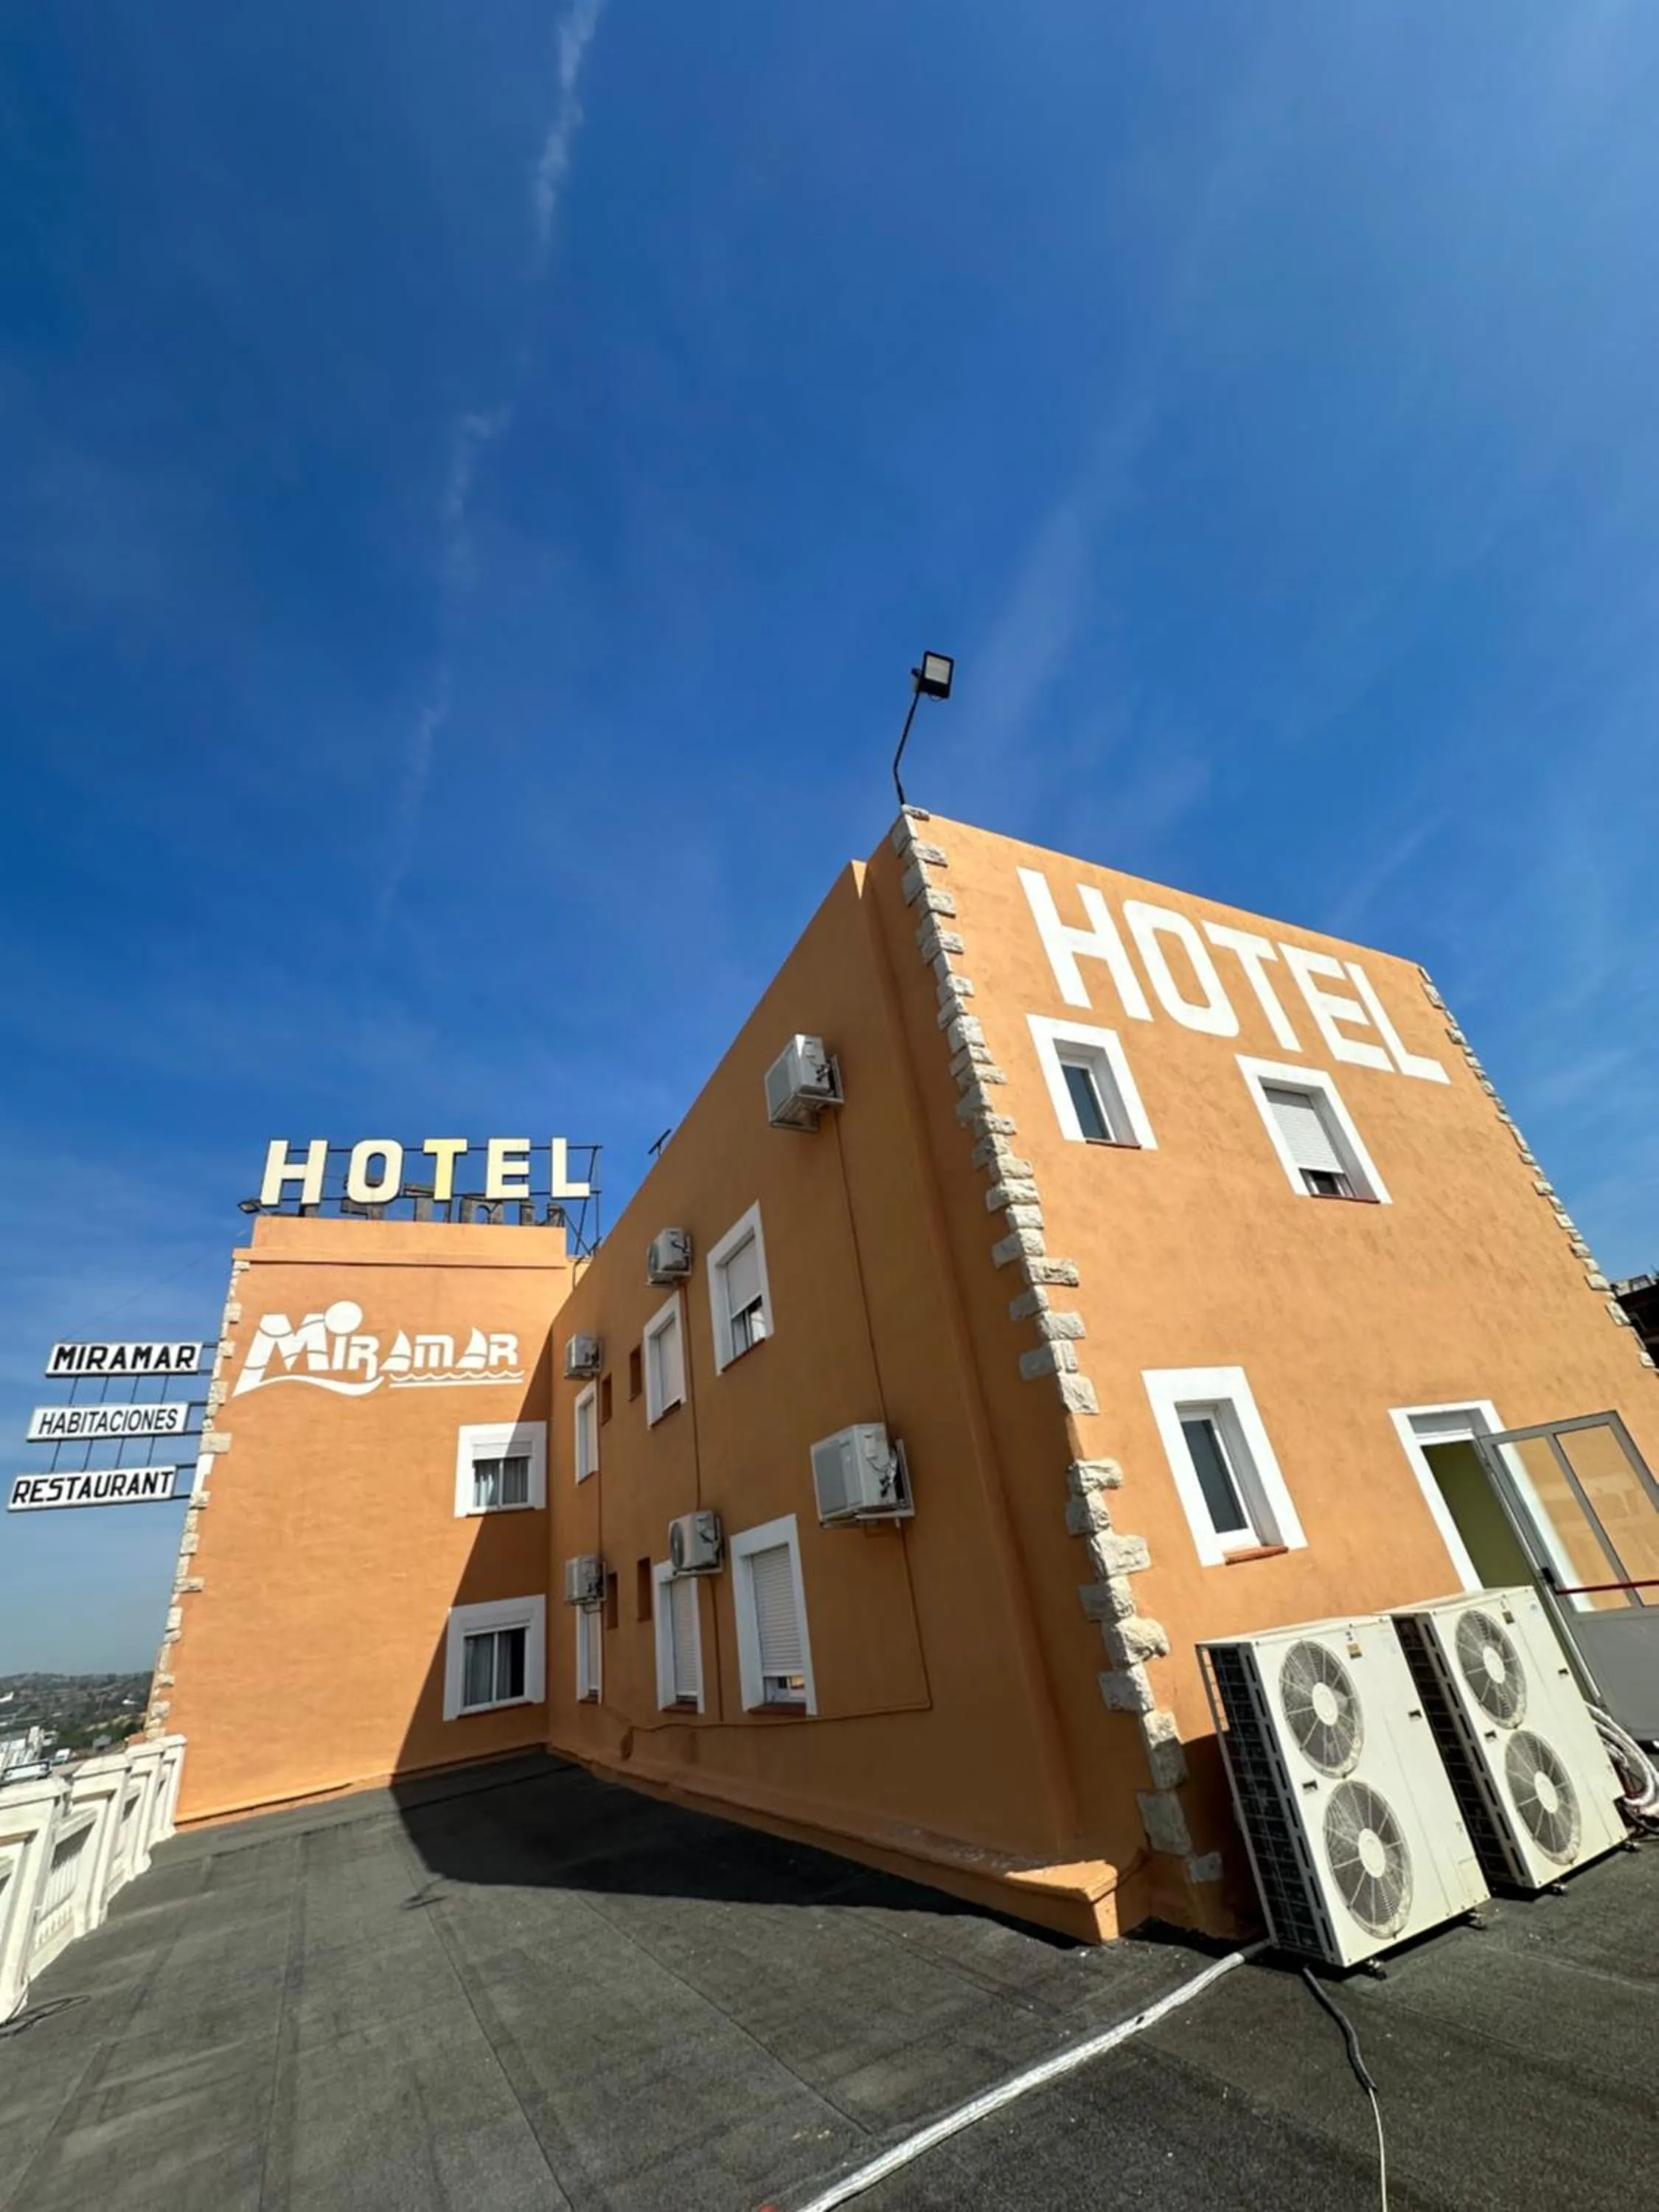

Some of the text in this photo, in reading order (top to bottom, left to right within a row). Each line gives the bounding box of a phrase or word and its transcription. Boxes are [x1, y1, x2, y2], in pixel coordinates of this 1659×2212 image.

[1016, 866, 1450, 1085] HOTEL
[260, 1138, 591, 1206] HOTEL
[52, 1346, 196, 1371] MIRAMAR
[38, 1408, 178, 1434] HABITACIONES
[12, 1470, 174, 1504] RESTAURANT
